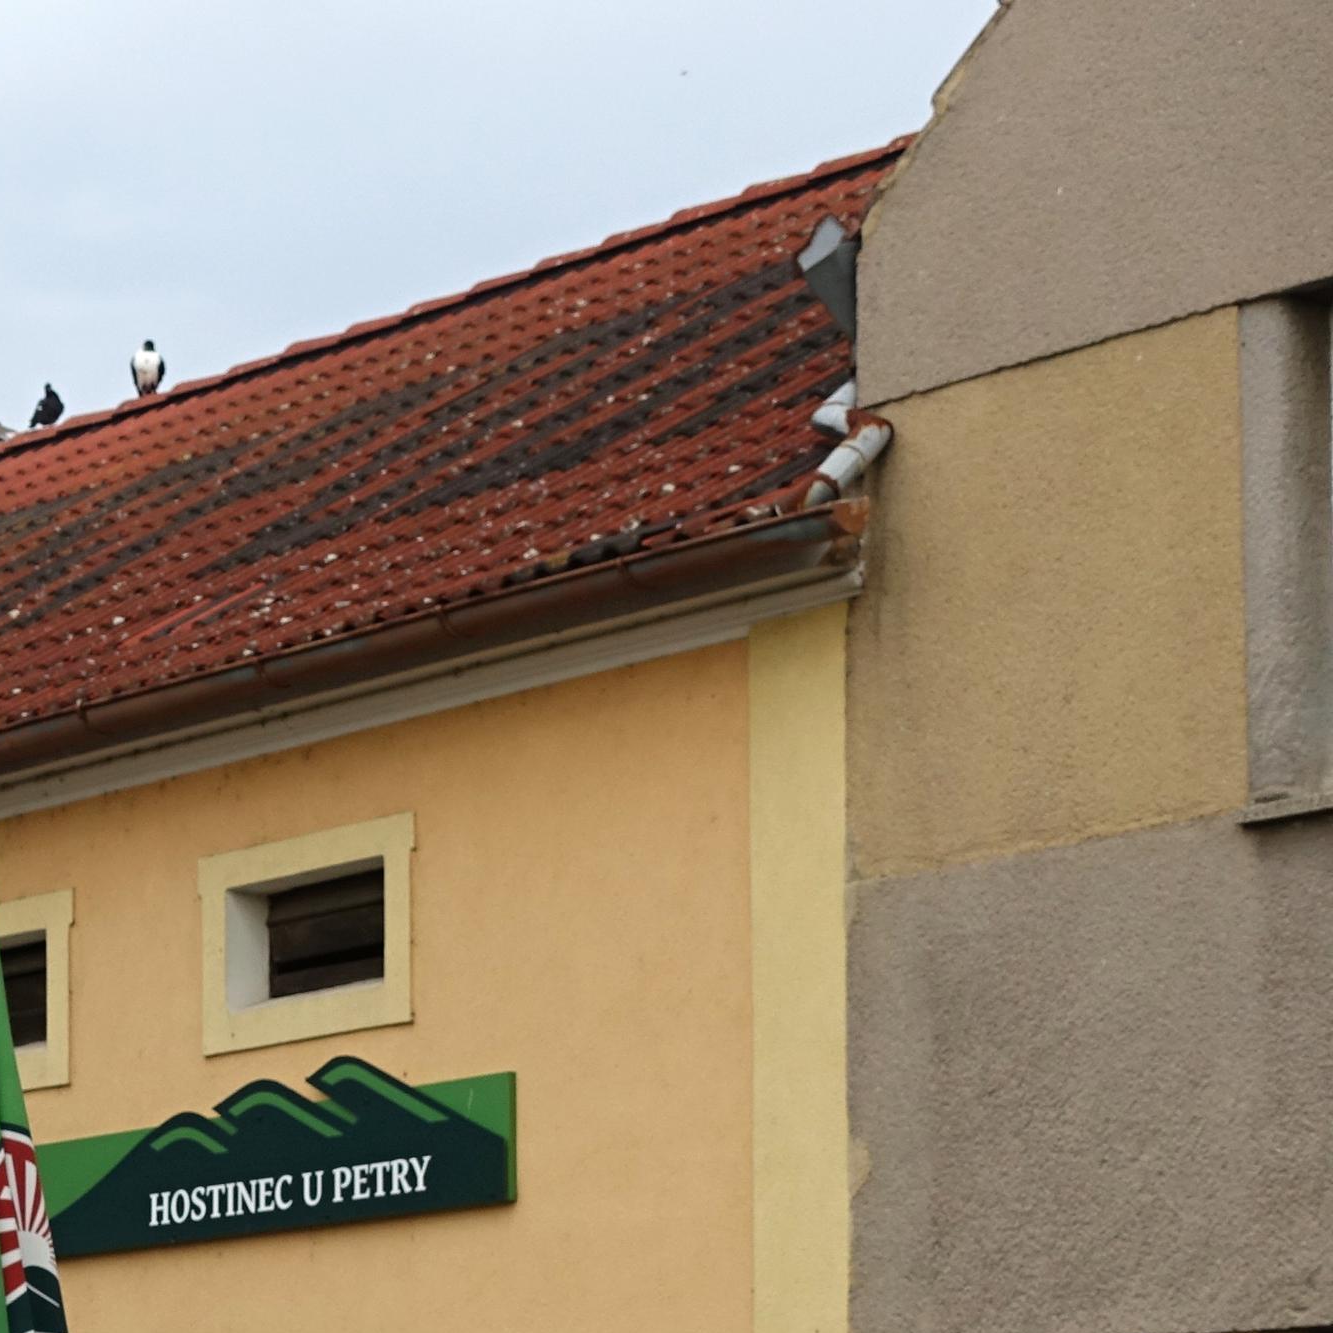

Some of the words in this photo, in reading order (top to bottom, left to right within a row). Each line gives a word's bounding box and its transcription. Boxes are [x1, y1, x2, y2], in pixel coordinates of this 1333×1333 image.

[148, 1174, 293, 1227] HOSTINEC
[301, 1170, 324, 1207] U
[331, 1155, 432, 1203] PETRY
